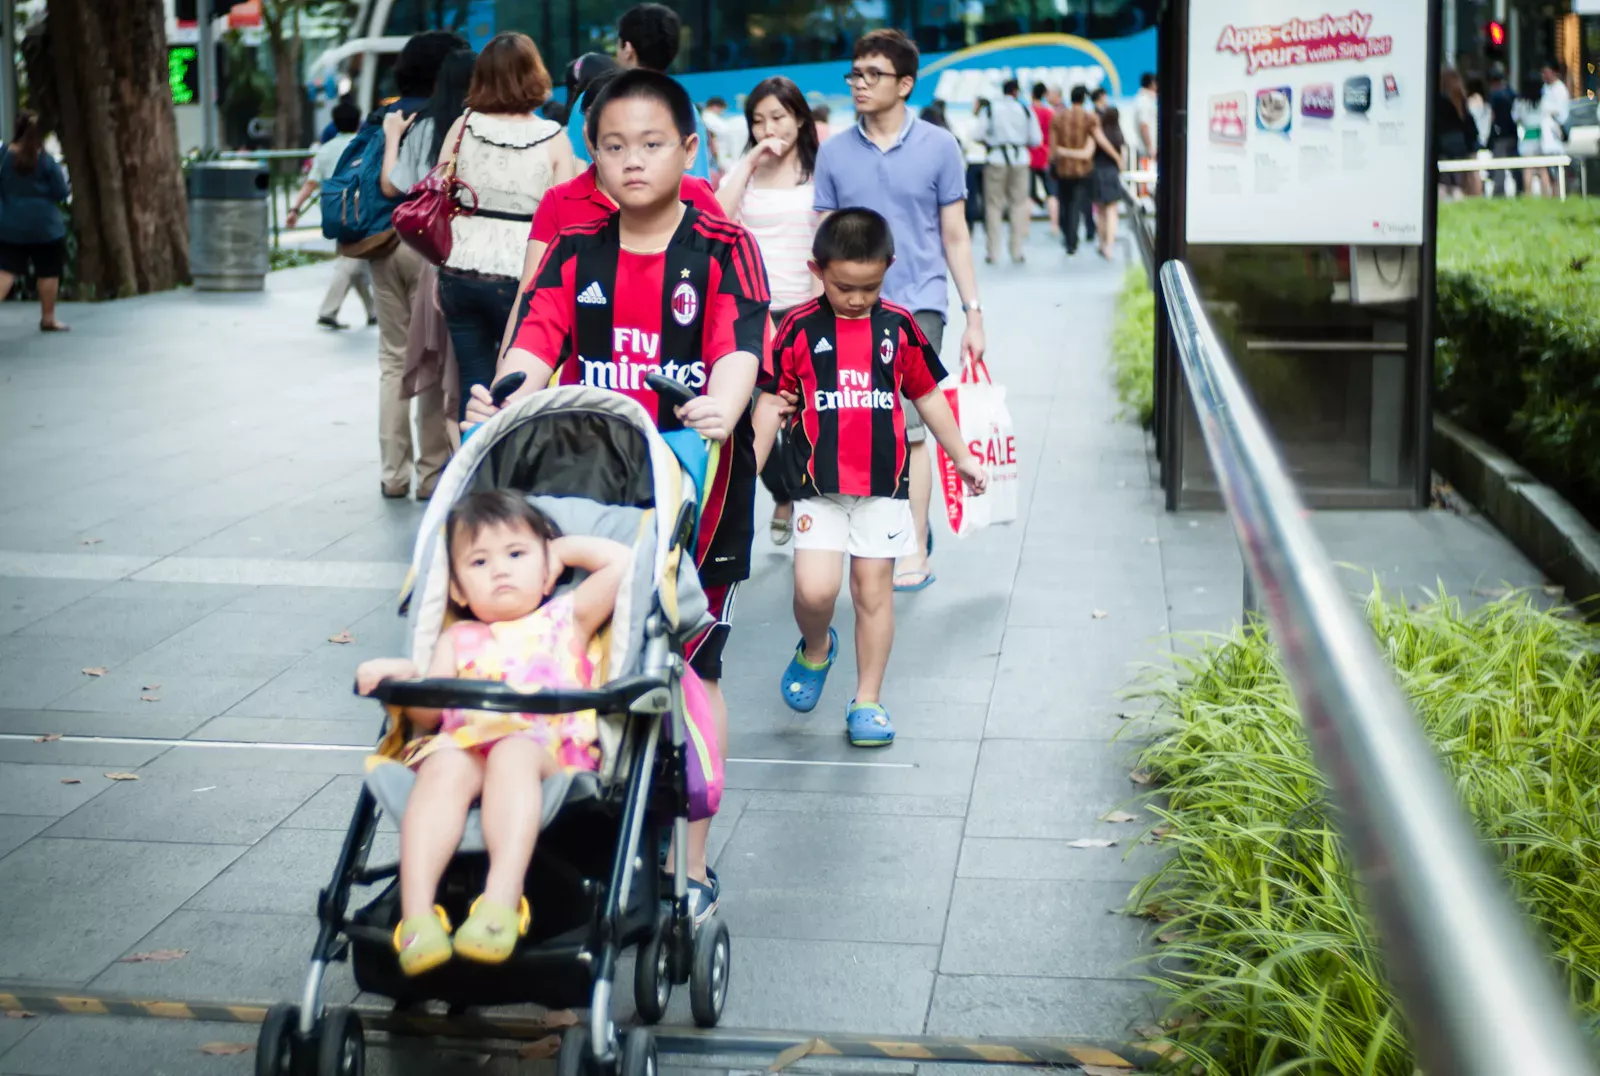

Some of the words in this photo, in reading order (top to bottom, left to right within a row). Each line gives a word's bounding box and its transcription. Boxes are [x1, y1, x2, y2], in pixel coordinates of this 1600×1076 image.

[1218, 11, 1371, 53] Apps-clusively
[1247, 45, 1306, 74] yours
[1308, 45, 1336, 61] with
[577, 295, 607, 304] adidas
[613, 328, 659, 358] Fly
[578, 355, 707, 390] mirates
[838, 369, 869, 388] Fly
[814, 386, 894, 411] Emirates
[968, 435, 1016, 467] SALE
